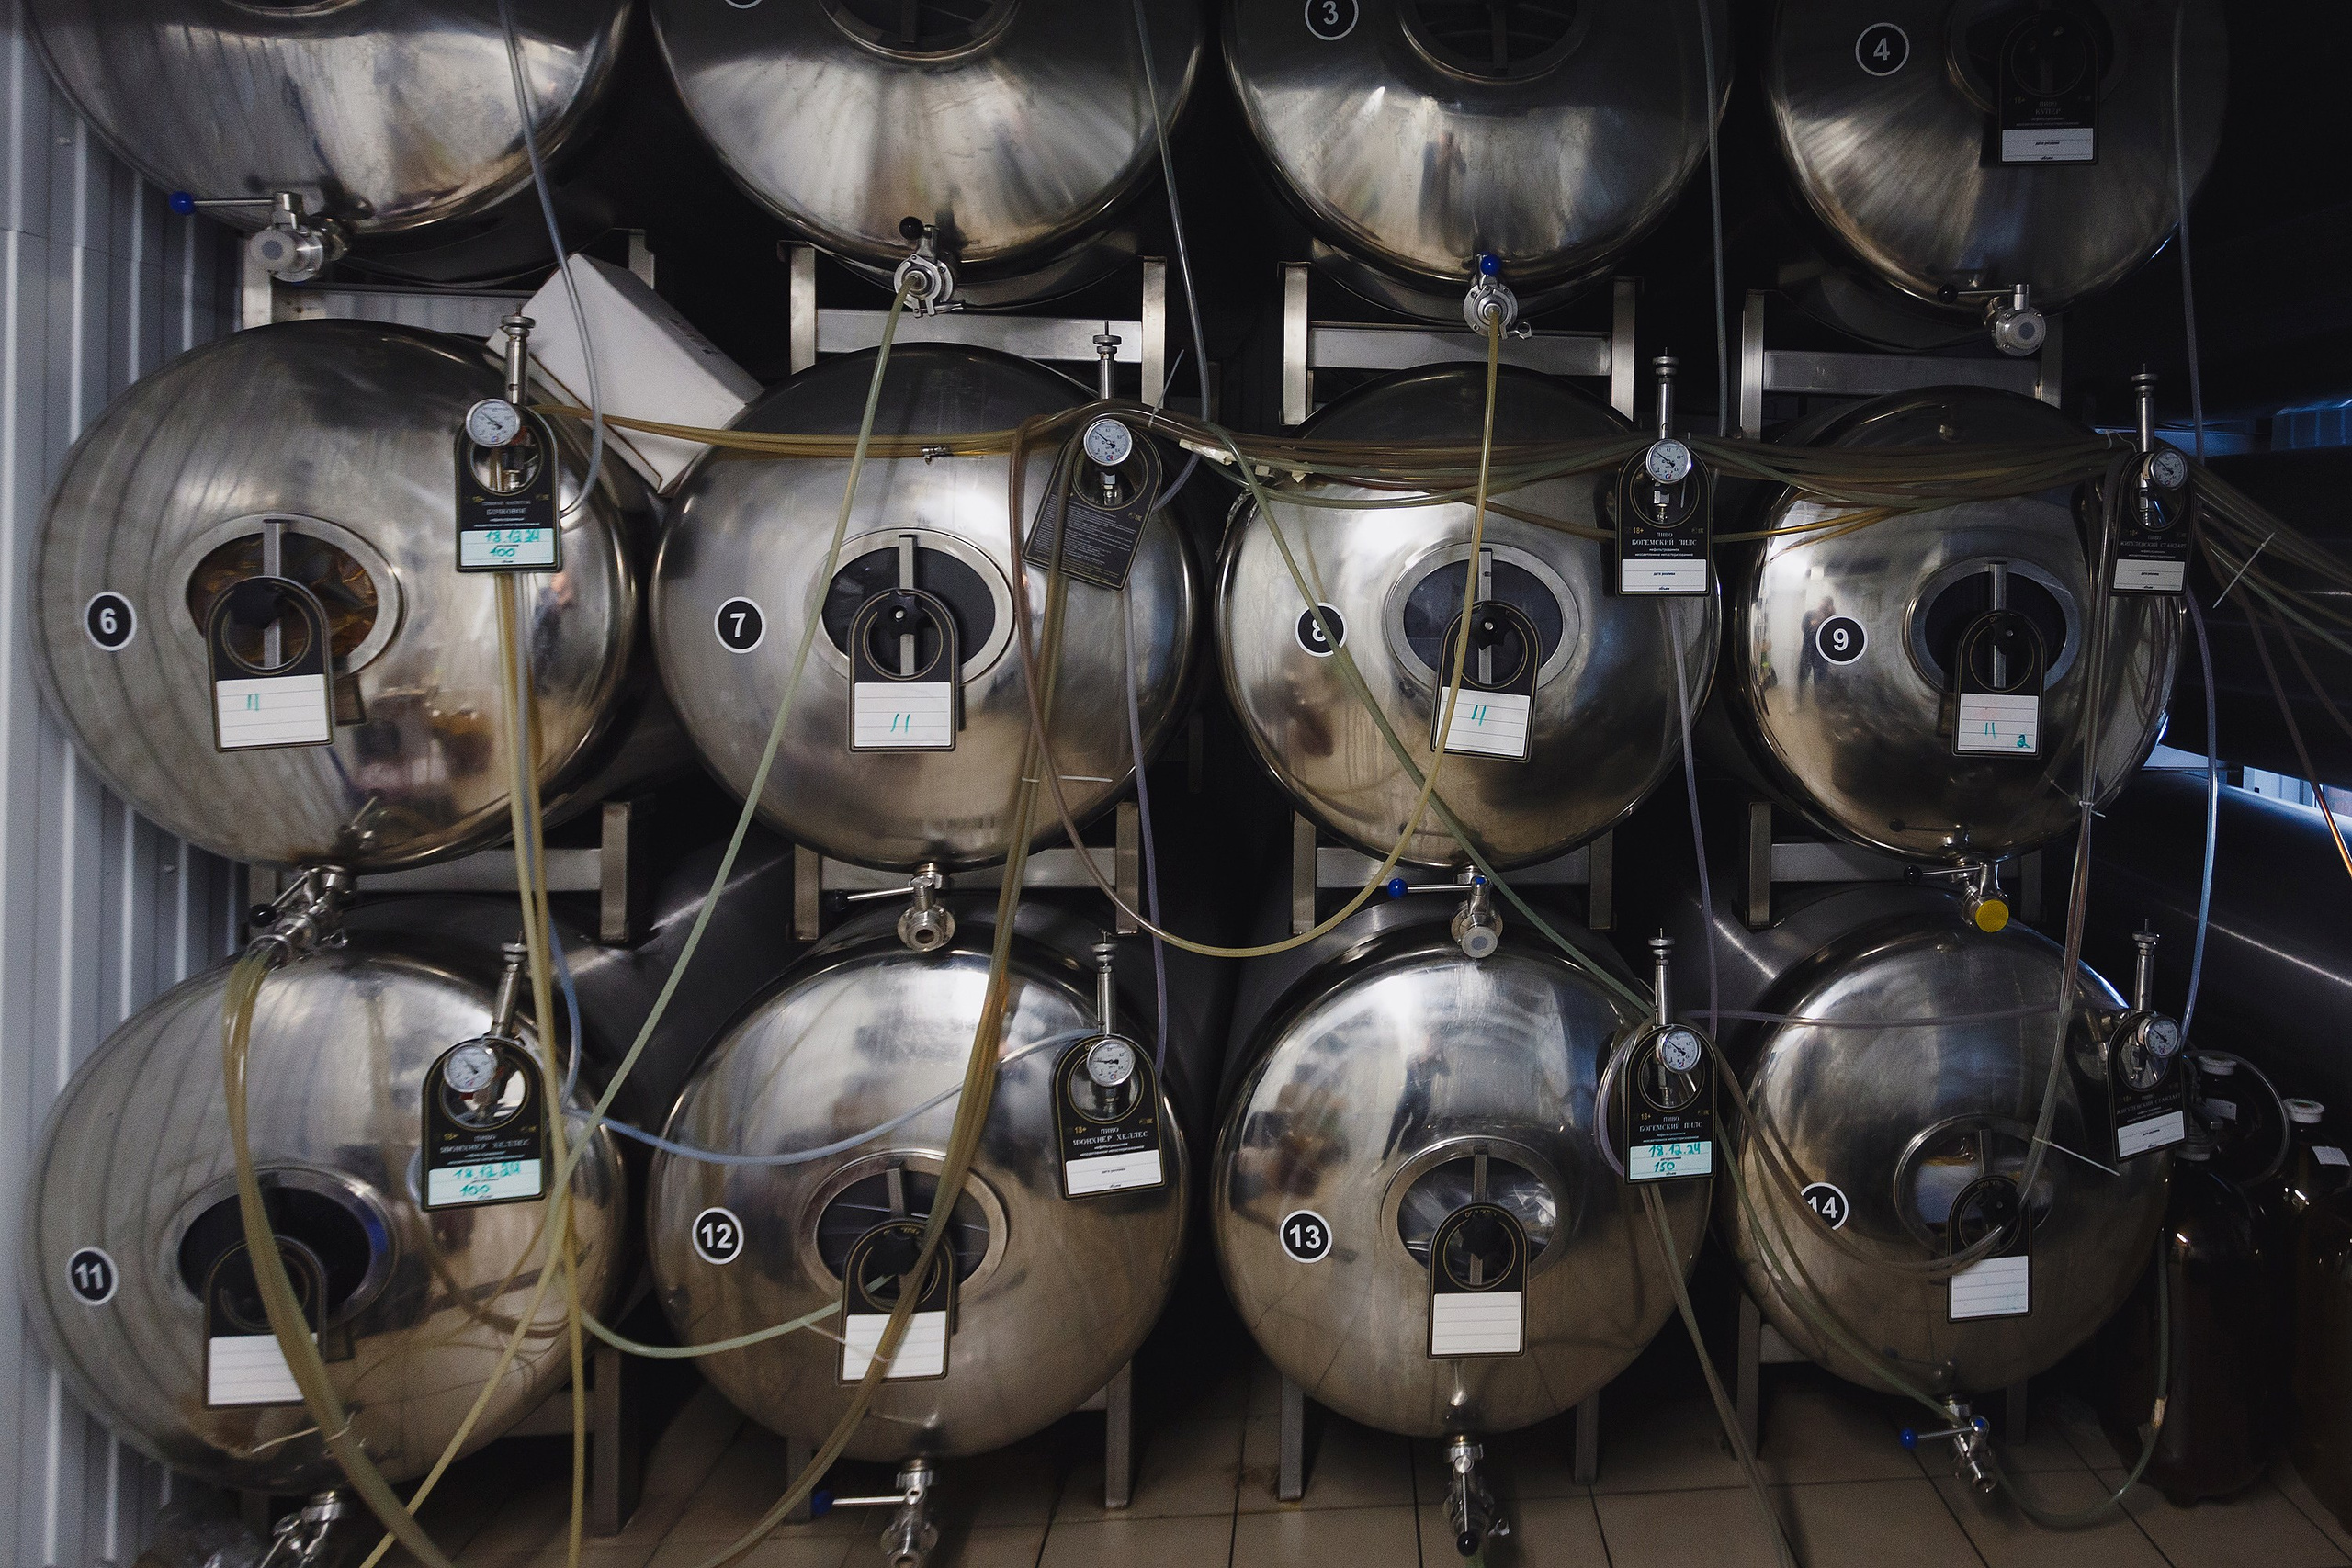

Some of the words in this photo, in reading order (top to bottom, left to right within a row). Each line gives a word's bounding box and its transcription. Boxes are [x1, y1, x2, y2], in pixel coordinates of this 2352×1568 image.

[1322, 0, 1339, 25] 3
[1872, 38, 1891, 61] 4
[99, 607, 119, 635] 6
[729, 612, 746, 637] 7
[1311, 618, 1328, 643] 8
[1832, 627, 1849, 652] 9
[1639, 1122, 1680, 1132] БОГЕМСКИЙ
[1640, 1112, 1651, 1121] 18+
[1116, 1130, 1148, 1141] ХЕЛЛЕС
[1648, 1141, 1701, 1158] 18.12.24
[1654, 1161, 1675, 1173] 150
[1806, 1196, 1838, 1219] 14
[701, 1221, 733, 1249] 12
[1289, 1224, 1321, 1249] 13
[74, 1261, 104, 1291] 11
